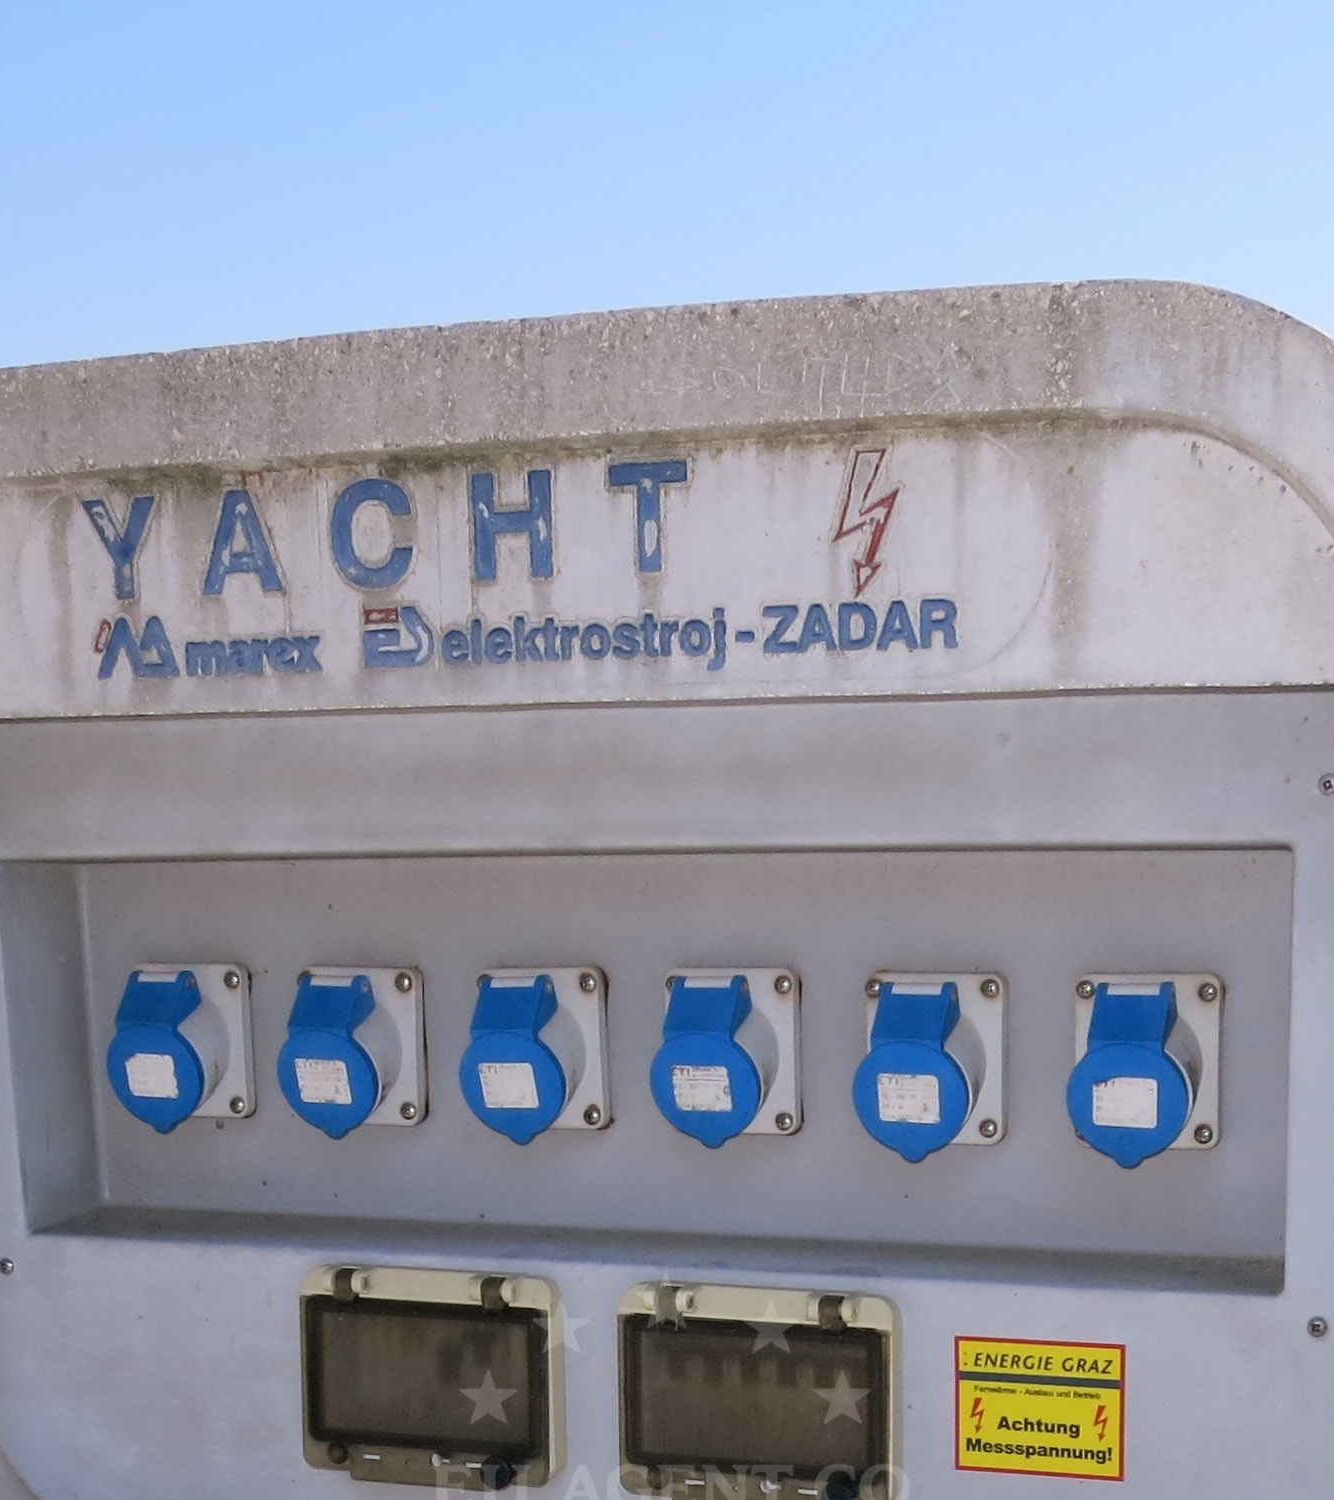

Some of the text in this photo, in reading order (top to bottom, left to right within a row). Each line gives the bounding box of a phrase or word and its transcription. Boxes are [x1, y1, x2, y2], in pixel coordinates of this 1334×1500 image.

[81, 459, 687, 600] YACHT
[185, 635, 324, 677] marex
[973, 1352, 1113, 1375] ENERGIE GRAZ
[997, 1416, 1080, 1439] Achtung
[966, 1437, 1113, 1465] Messspannung!
